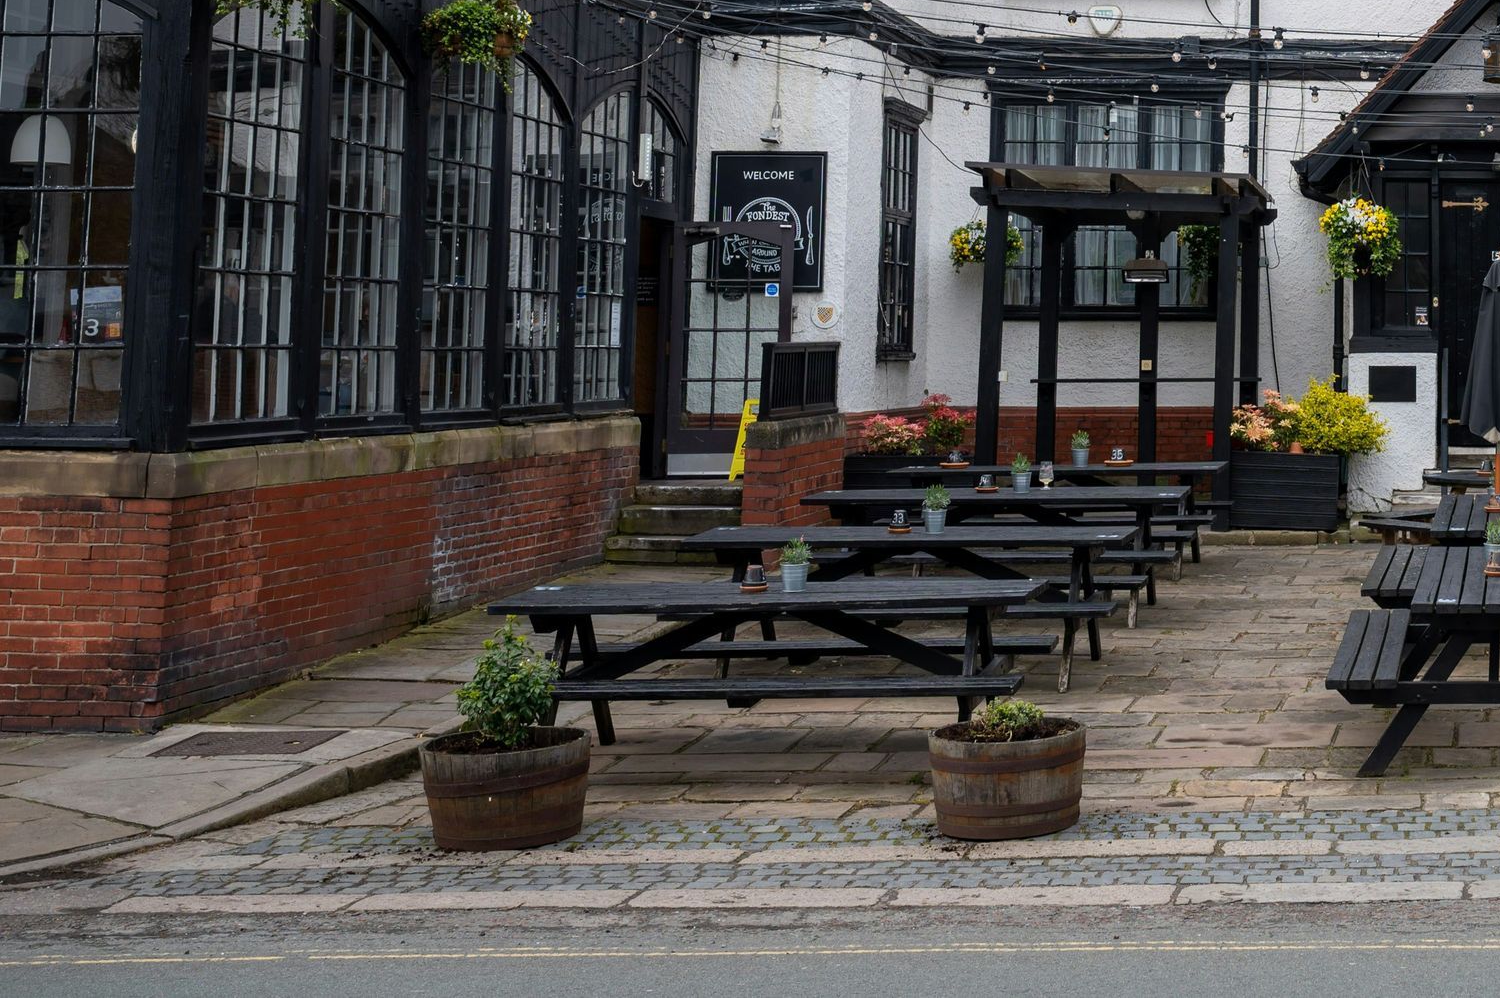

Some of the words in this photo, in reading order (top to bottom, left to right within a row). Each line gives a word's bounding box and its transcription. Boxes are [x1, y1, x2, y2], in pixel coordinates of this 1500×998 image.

[743, 170, 795, 181] WELCOME
[759, 202, 777, 212] The
[746, 210, 790, 222] FONDEST
[751, 248, 778, 257] AROUND
[763, 263, 781, 273] TAB
[1111, 449, 1123, 460] 35
[892, 512, 904, 524] 33
